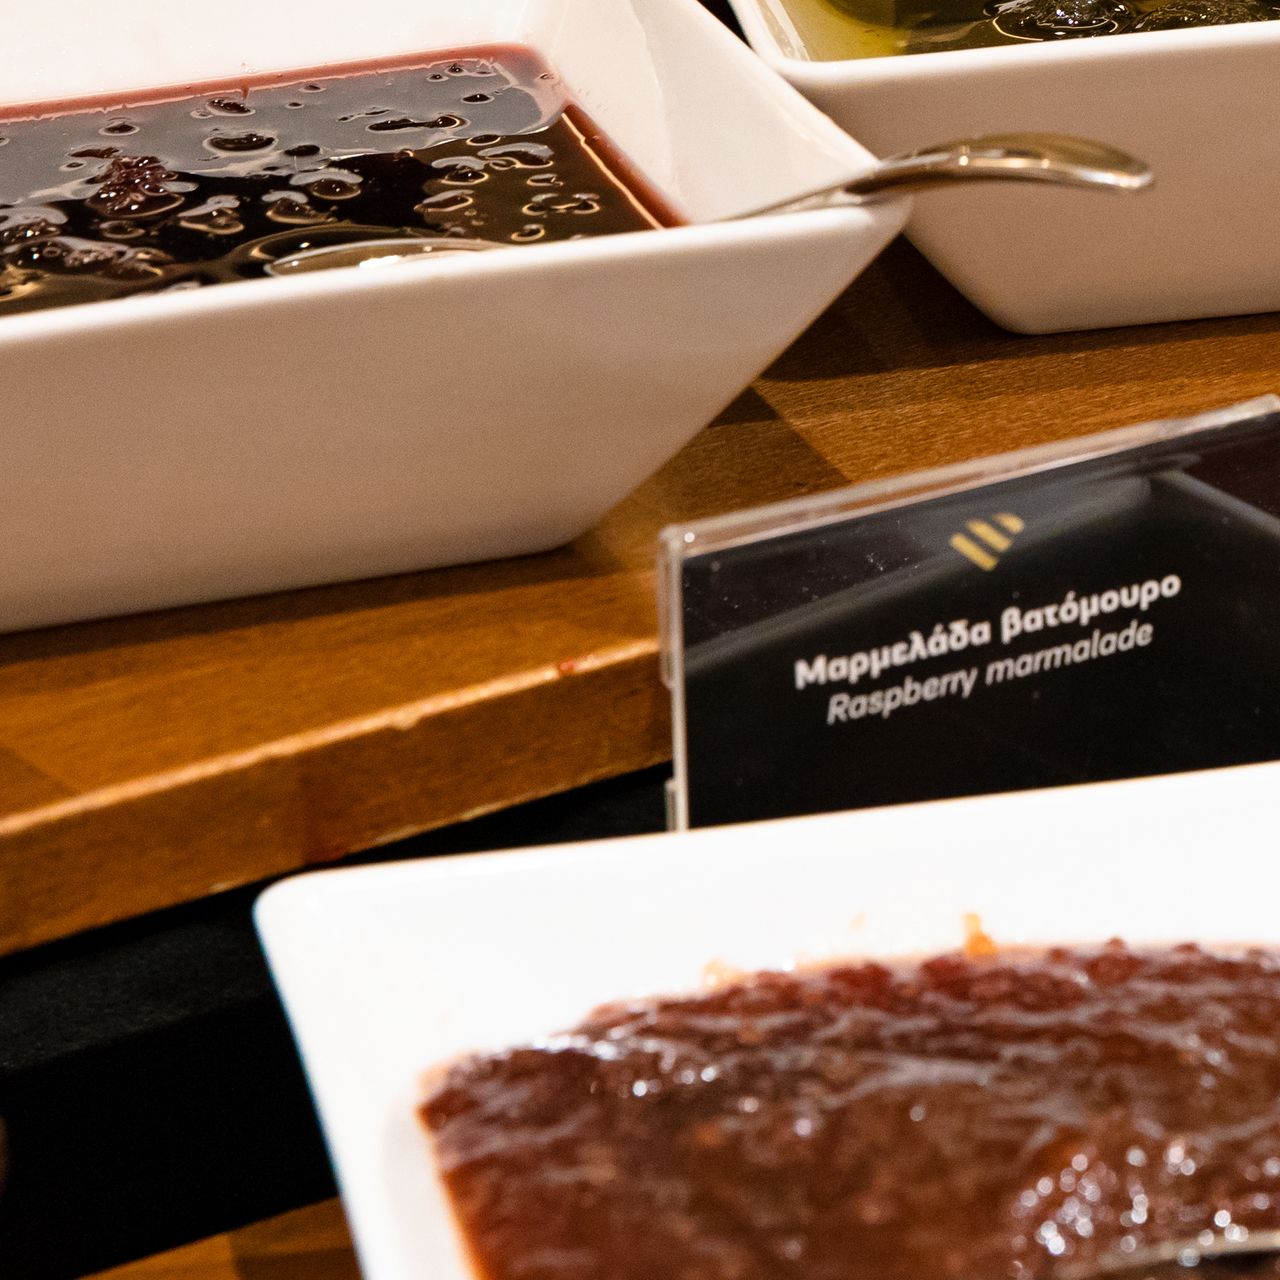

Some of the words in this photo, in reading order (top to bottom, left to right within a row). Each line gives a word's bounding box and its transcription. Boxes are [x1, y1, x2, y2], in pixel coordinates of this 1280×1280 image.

[794, 620, 991, 689] Μαρμελάδα
[1000, 574, 1182, 644] βατόμουρο
[827, 665, 978, 725] Raspberry
[985, 619, 1154, 686] marmalade
